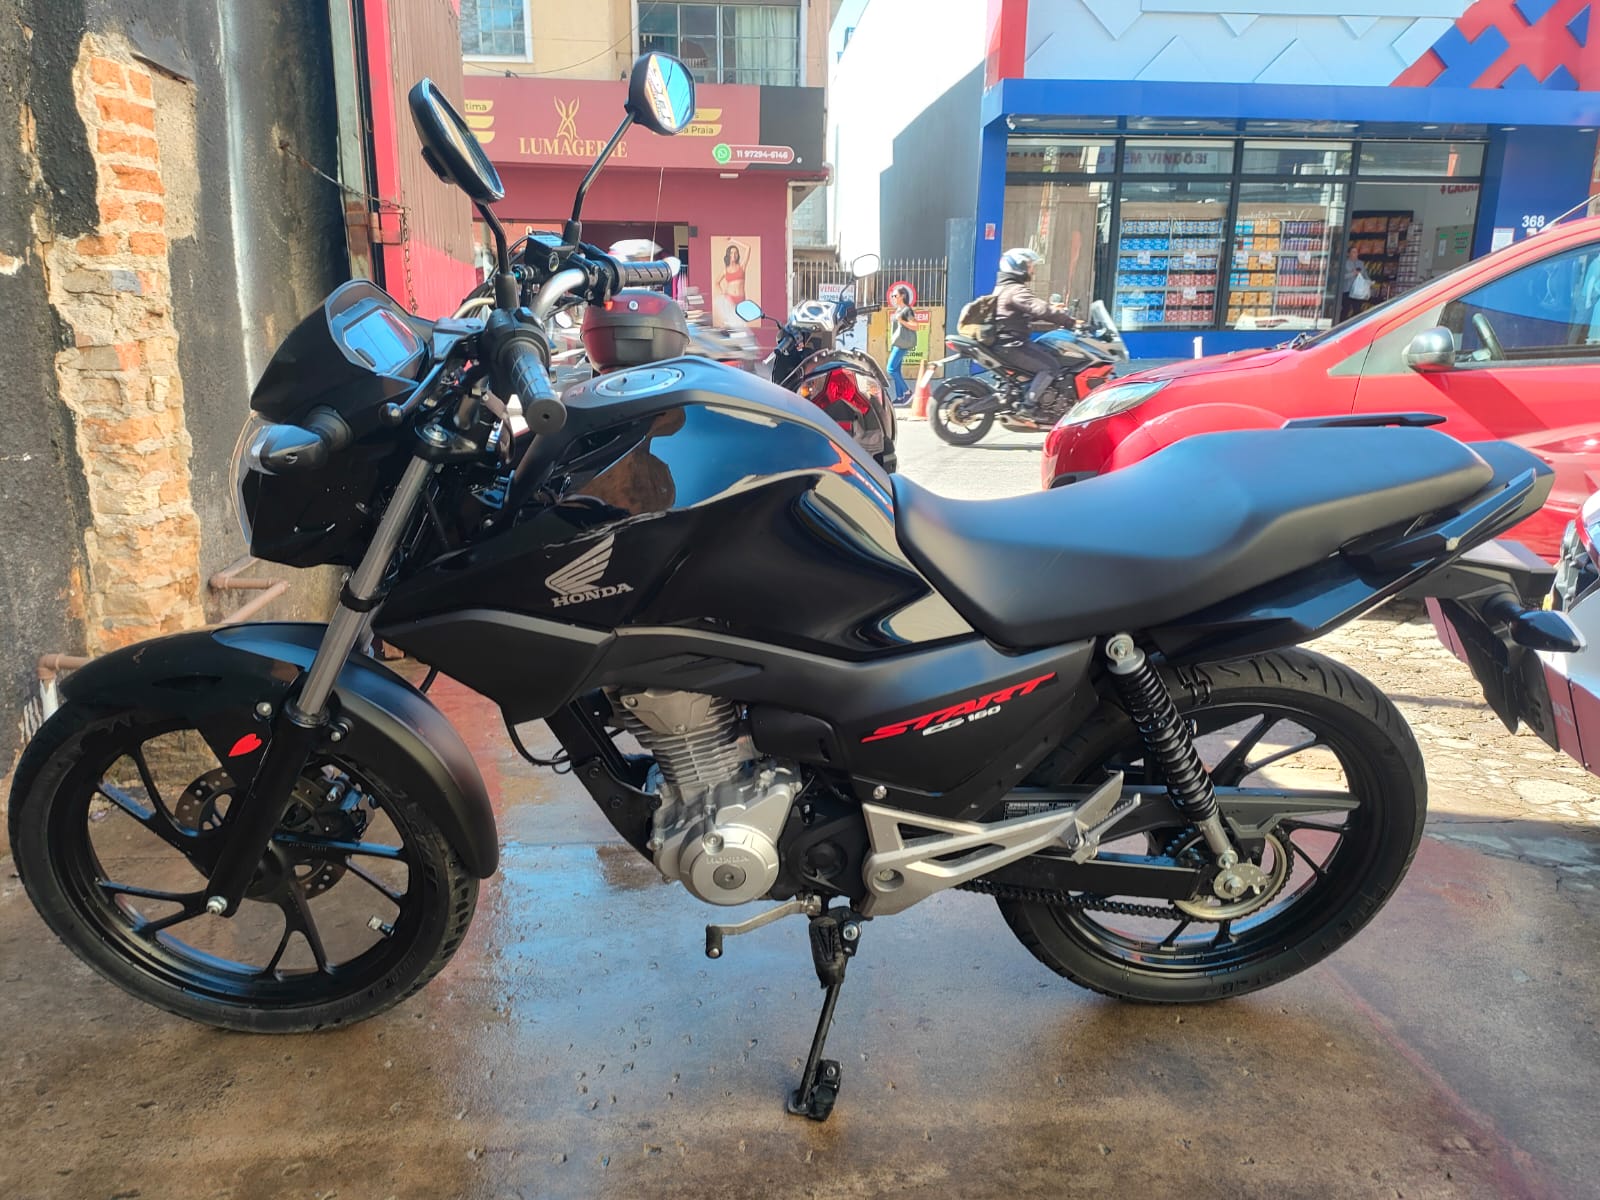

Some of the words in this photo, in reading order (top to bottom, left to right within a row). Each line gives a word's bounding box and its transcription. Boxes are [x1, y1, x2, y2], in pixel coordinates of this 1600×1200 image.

[691, 126, 715, 135] Praia
[1521, 214, 1545, 229] 368
[551, 582, 634, 608] HONDA
[860, 671, 1057, 744] START
[922, 716, 965, 737] CG
[967, 704, 1002, 723] 160
